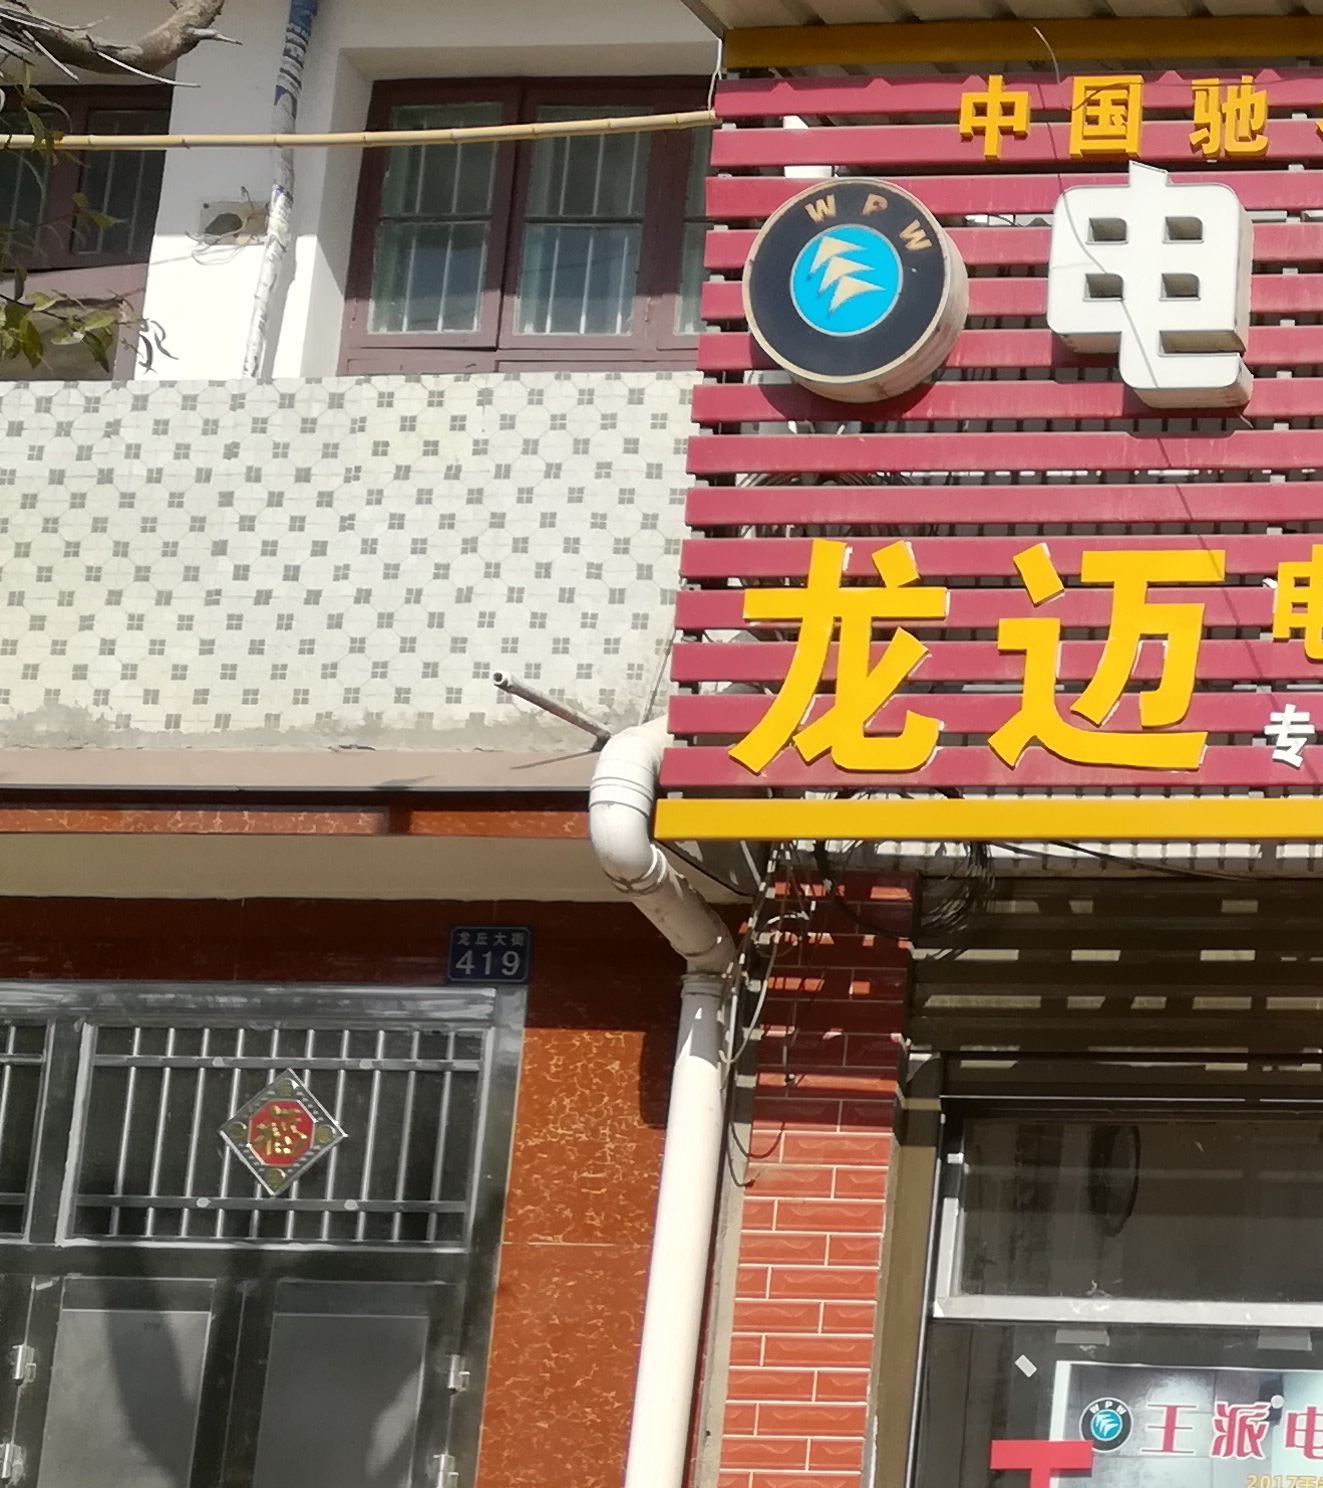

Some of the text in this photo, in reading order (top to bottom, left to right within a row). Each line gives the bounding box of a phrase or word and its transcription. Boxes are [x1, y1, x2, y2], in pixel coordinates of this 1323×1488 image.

[805, 193, 933, 251] WPW
[727, 537, 1230, 773] 龙迈
[456, 950, 520, 975] 419
